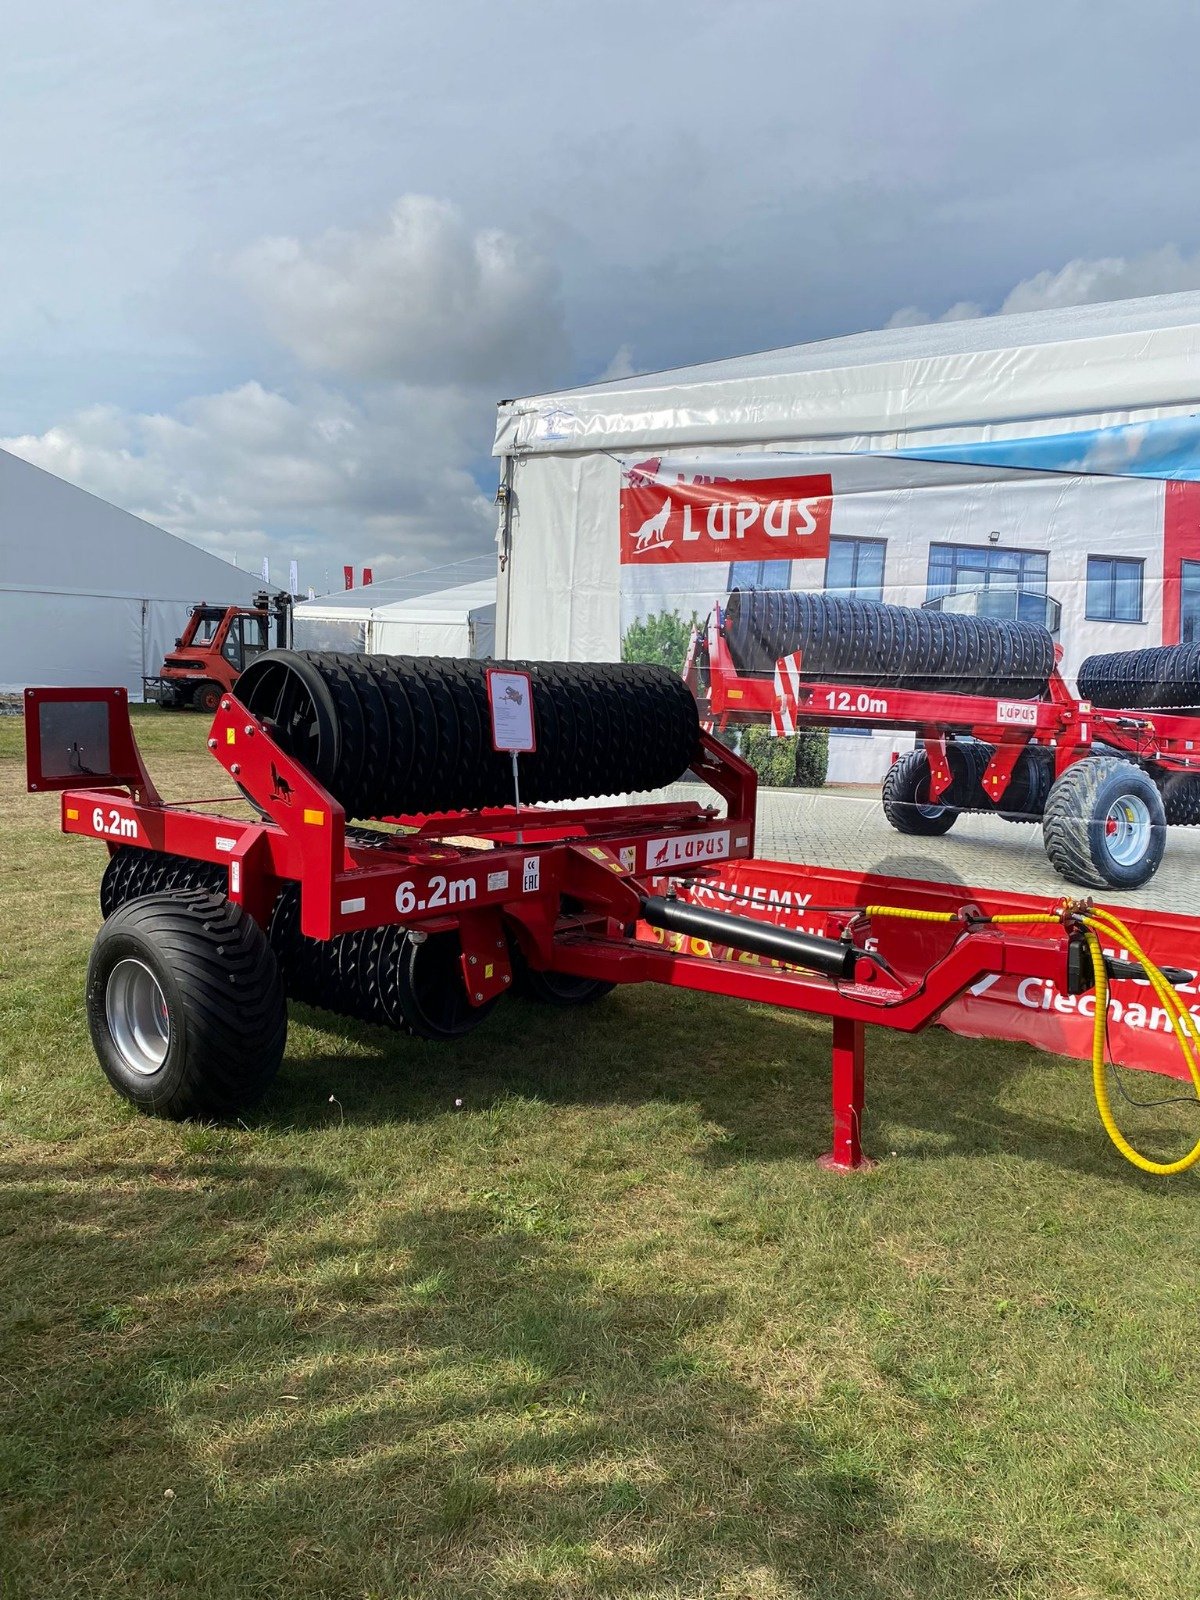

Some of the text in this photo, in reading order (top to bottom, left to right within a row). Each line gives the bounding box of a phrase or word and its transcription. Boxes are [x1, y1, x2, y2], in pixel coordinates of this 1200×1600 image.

[682, 499, 818, 541] LUPUS
[825, 691, 888, 714] 12.0m
[999, 707, 1036, 721] LUPUS
[92, 807, 138, 838] 6.2m
[674, 837, 724, 860] LUPUS
[524, 874, 539, 891] EAC
[395, 875, 477, 914] 6.2m
